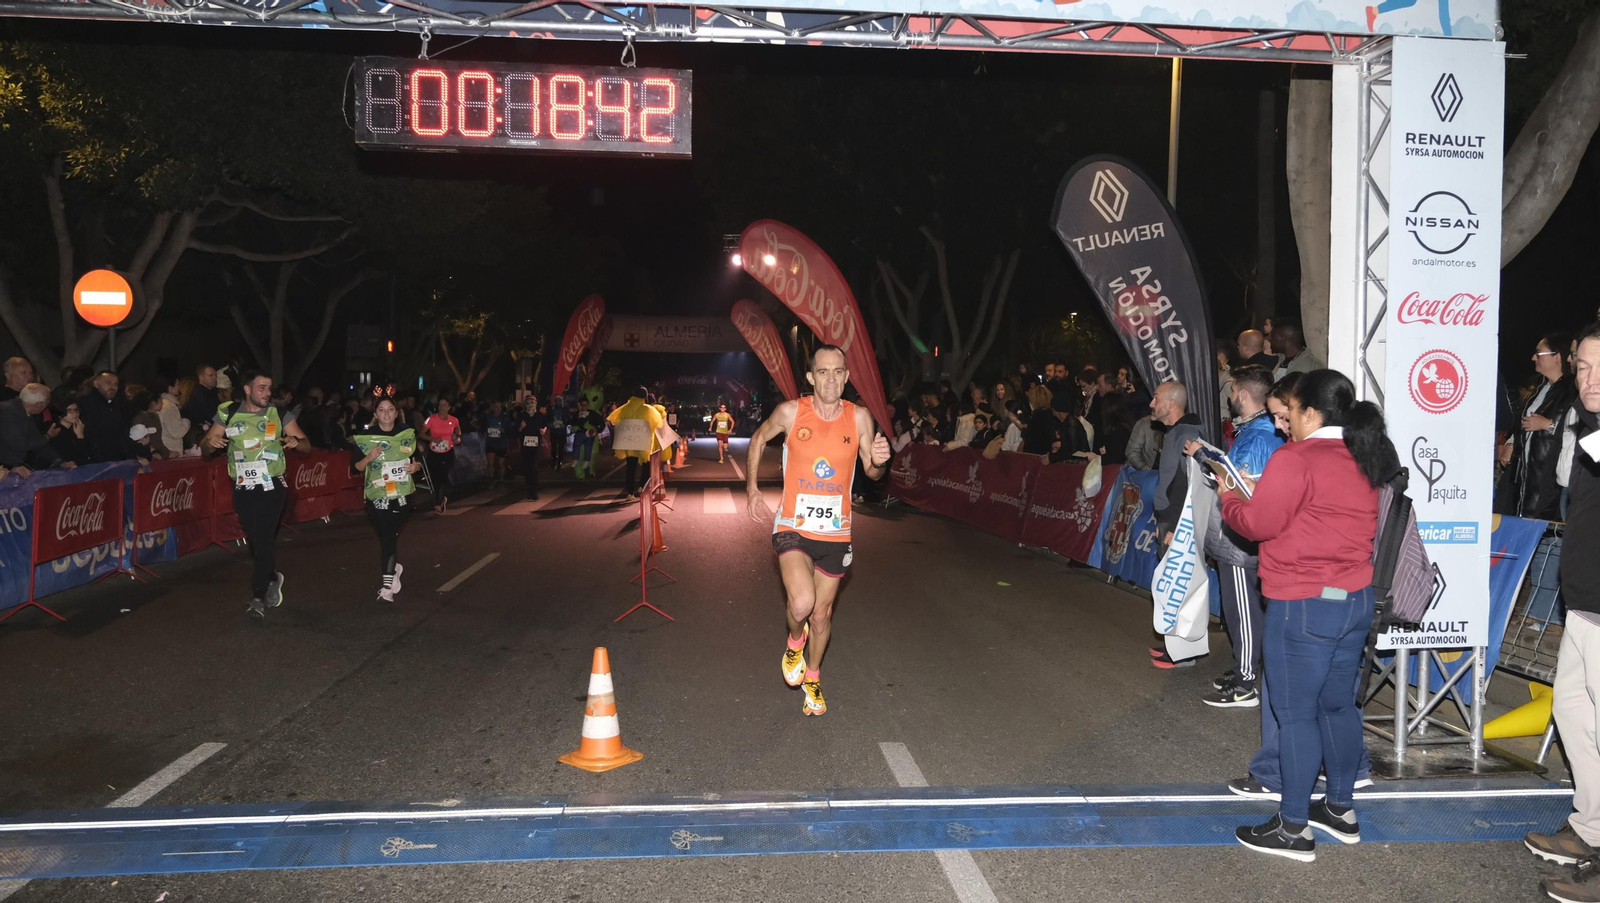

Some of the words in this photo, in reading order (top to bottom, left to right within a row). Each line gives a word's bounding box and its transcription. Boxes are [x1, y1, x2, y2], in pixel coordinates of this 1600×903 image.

[411, 69, 675, 143] 00:18:42
[1405, 132, 1486, 148] RENAULT
[1405, 147, 1430, 158] SYRSA
[1431, 149, 1484, 160] AUTOMOCION
[1405, 216, 1480, 229] NISSAN
[1412, 257, 1477, 268] andalmotor.es
[654, 325, 722, 338] ALMERÍA
[245, 469, 257, 477] 66
[391, 467, 403, 475] 65
[1428, 459, 1467, 504] Paquita
[806, 506, 833, 518] 795
[1418, 525, 1453, 540] ericar
[1156, 548, 1184, 593] SAN
[1390, 636, 1414, 646] SYRSA
[1416, 635, 1467, 645] AUTOMOCION
